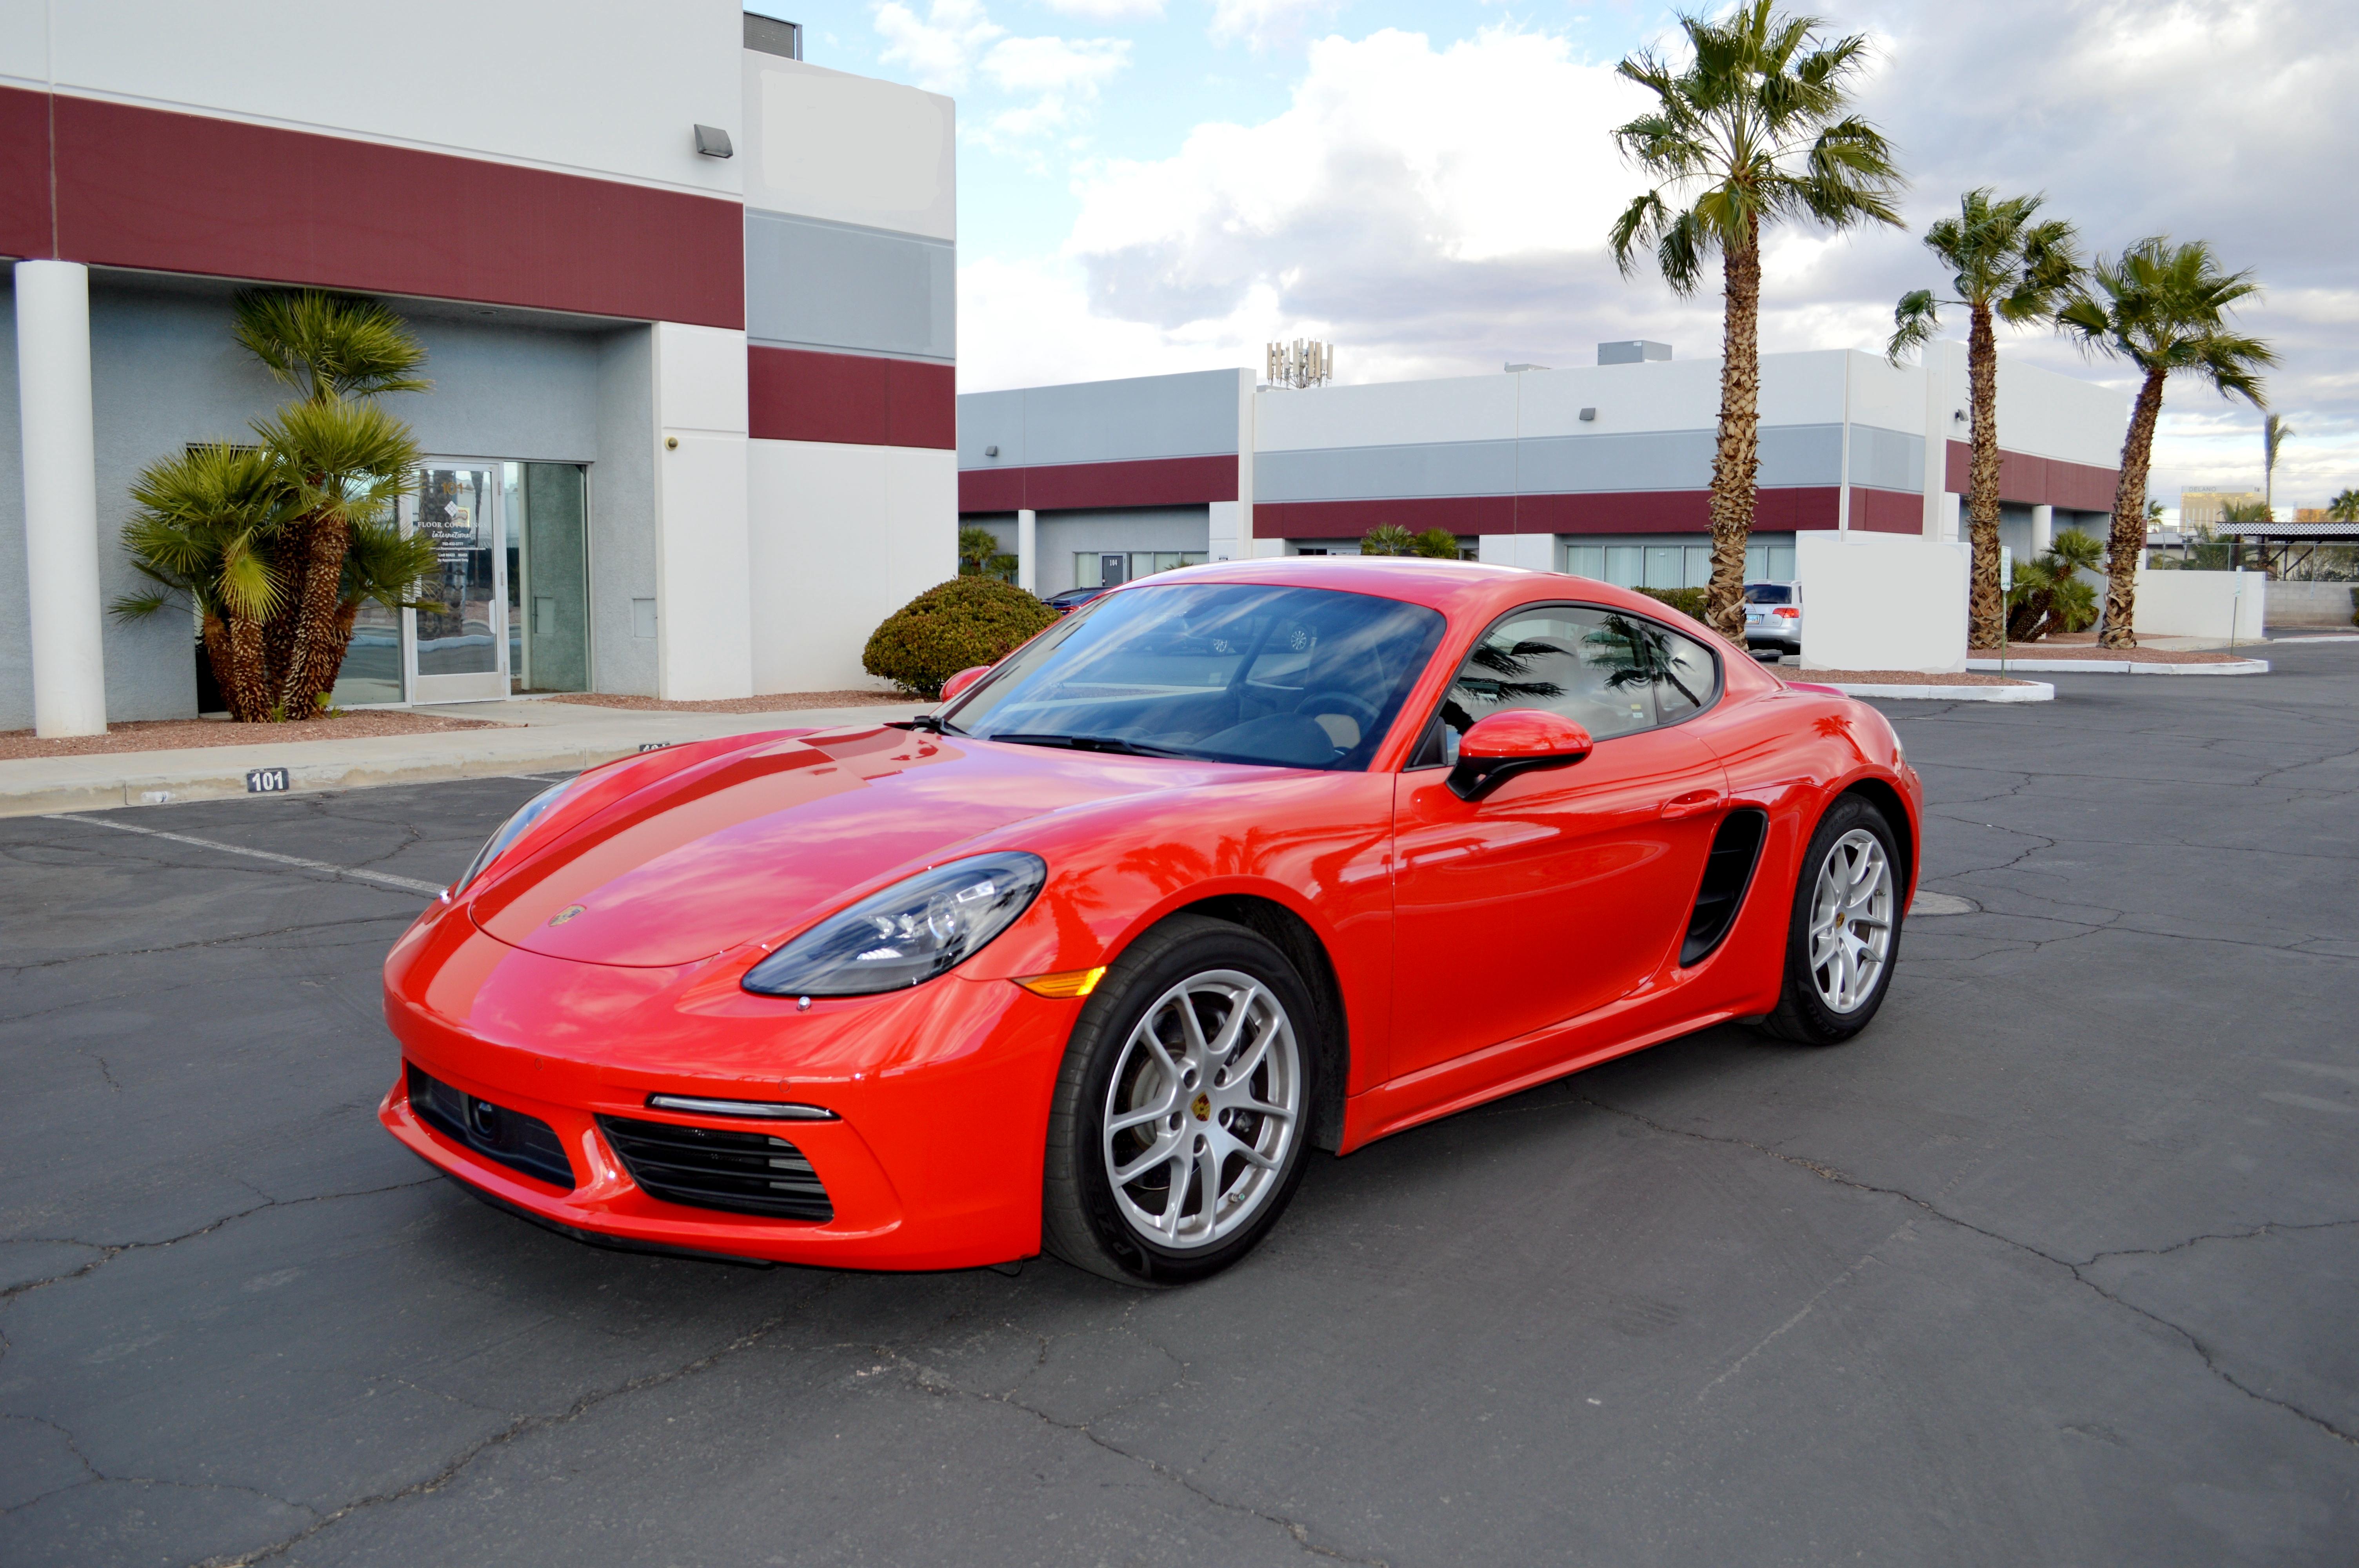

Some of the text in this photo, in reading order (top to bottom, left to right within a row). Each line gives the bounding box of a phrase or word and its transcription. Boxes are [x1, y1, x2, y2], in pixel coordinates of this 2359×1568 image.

[442, 482, 463, 495] 101
[432, 530, 473, 540] international
[252, 771, 283, 791] 101
